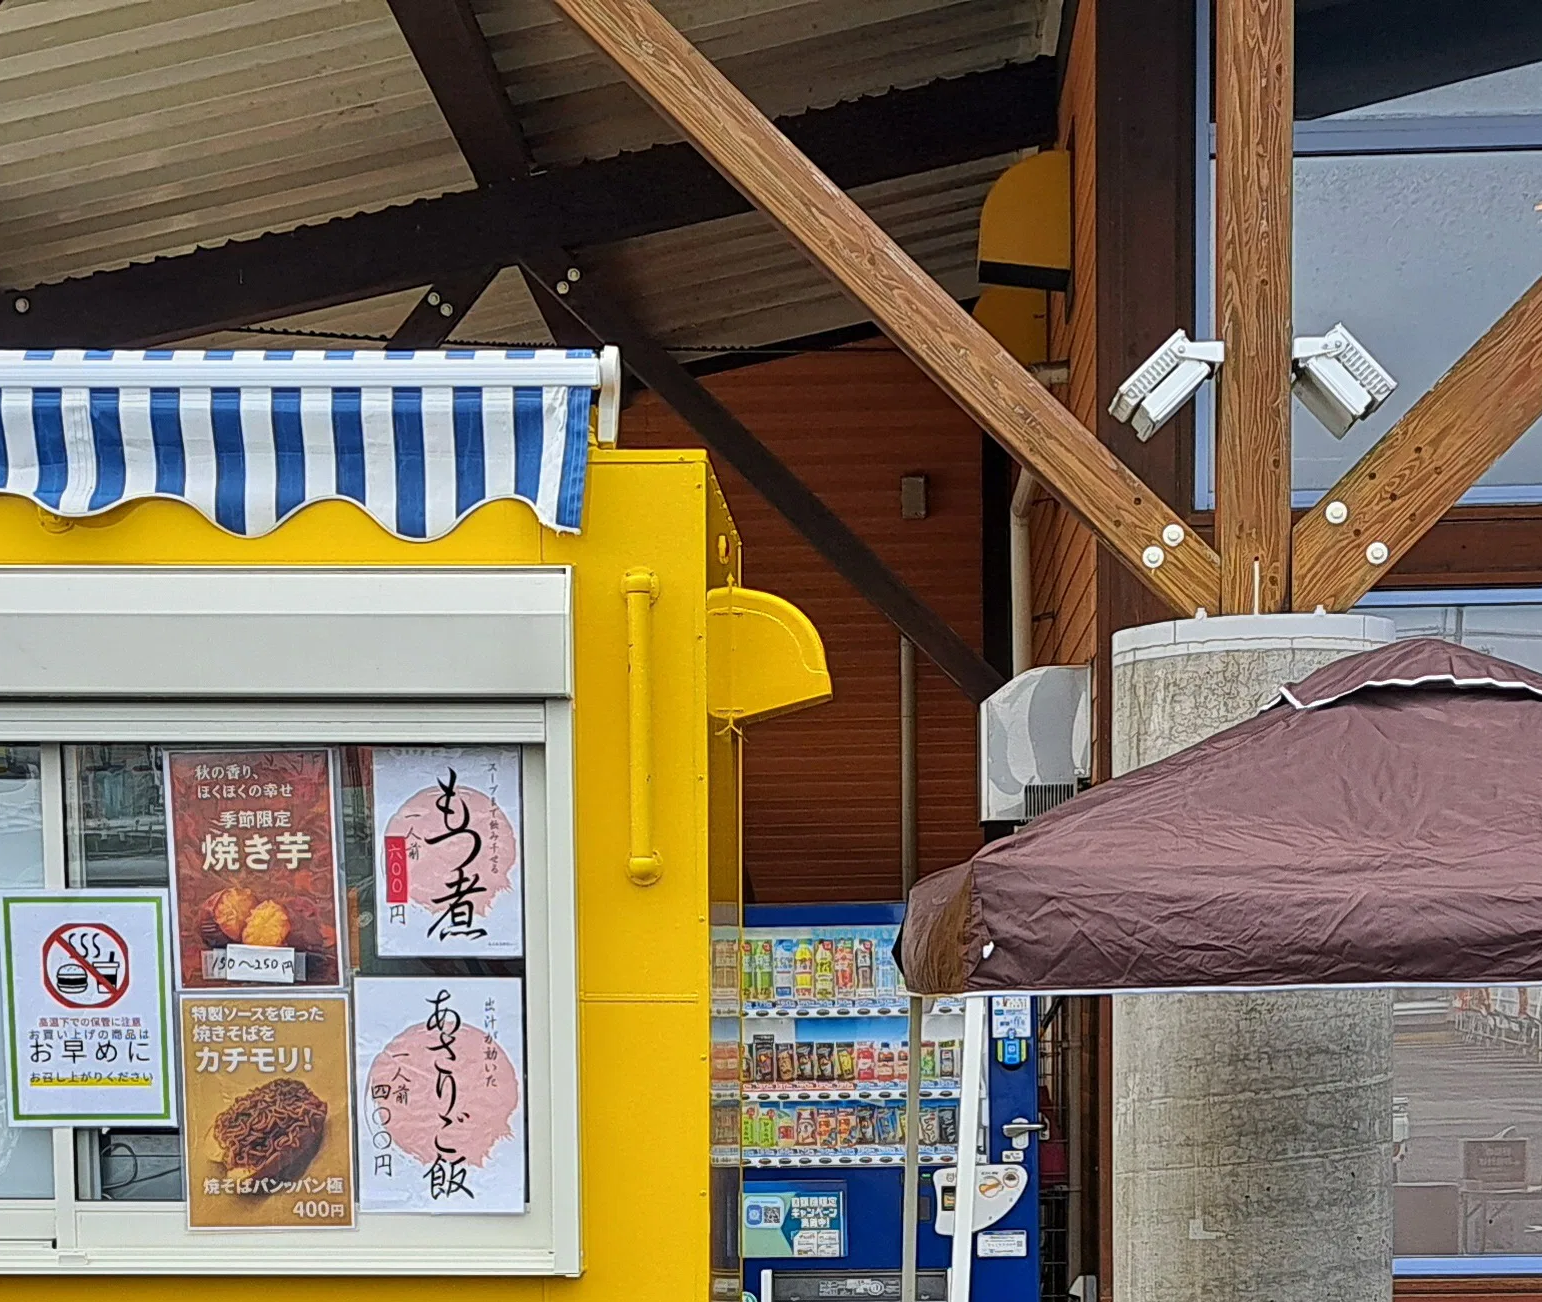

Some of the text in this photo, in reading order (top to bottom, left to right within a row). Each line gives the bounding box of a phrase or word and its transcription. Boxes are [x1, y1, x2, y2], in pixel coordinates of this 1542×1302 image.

[197, 784, 293, 798] ほくほくの幸せ
[219, 811, 292, 828] 季節限定
[202, 832, 312, 870] 焼き芋
[425, 767, 488, 940] もつ煮
[191, 1006, 324, 1022] 特製ソースを使った
[29, 1029, 149, 1040] お買い上げの商品は
[193, 1025, 275, 1042] 焼きそばを
[30, 1040, 151, 1064] お早めに
[30, 1071, 153, 1083] お召し上がりください
[423, 989, 474, 1200] あさりご飯
[293, 1201, 345, 1218] 400円
